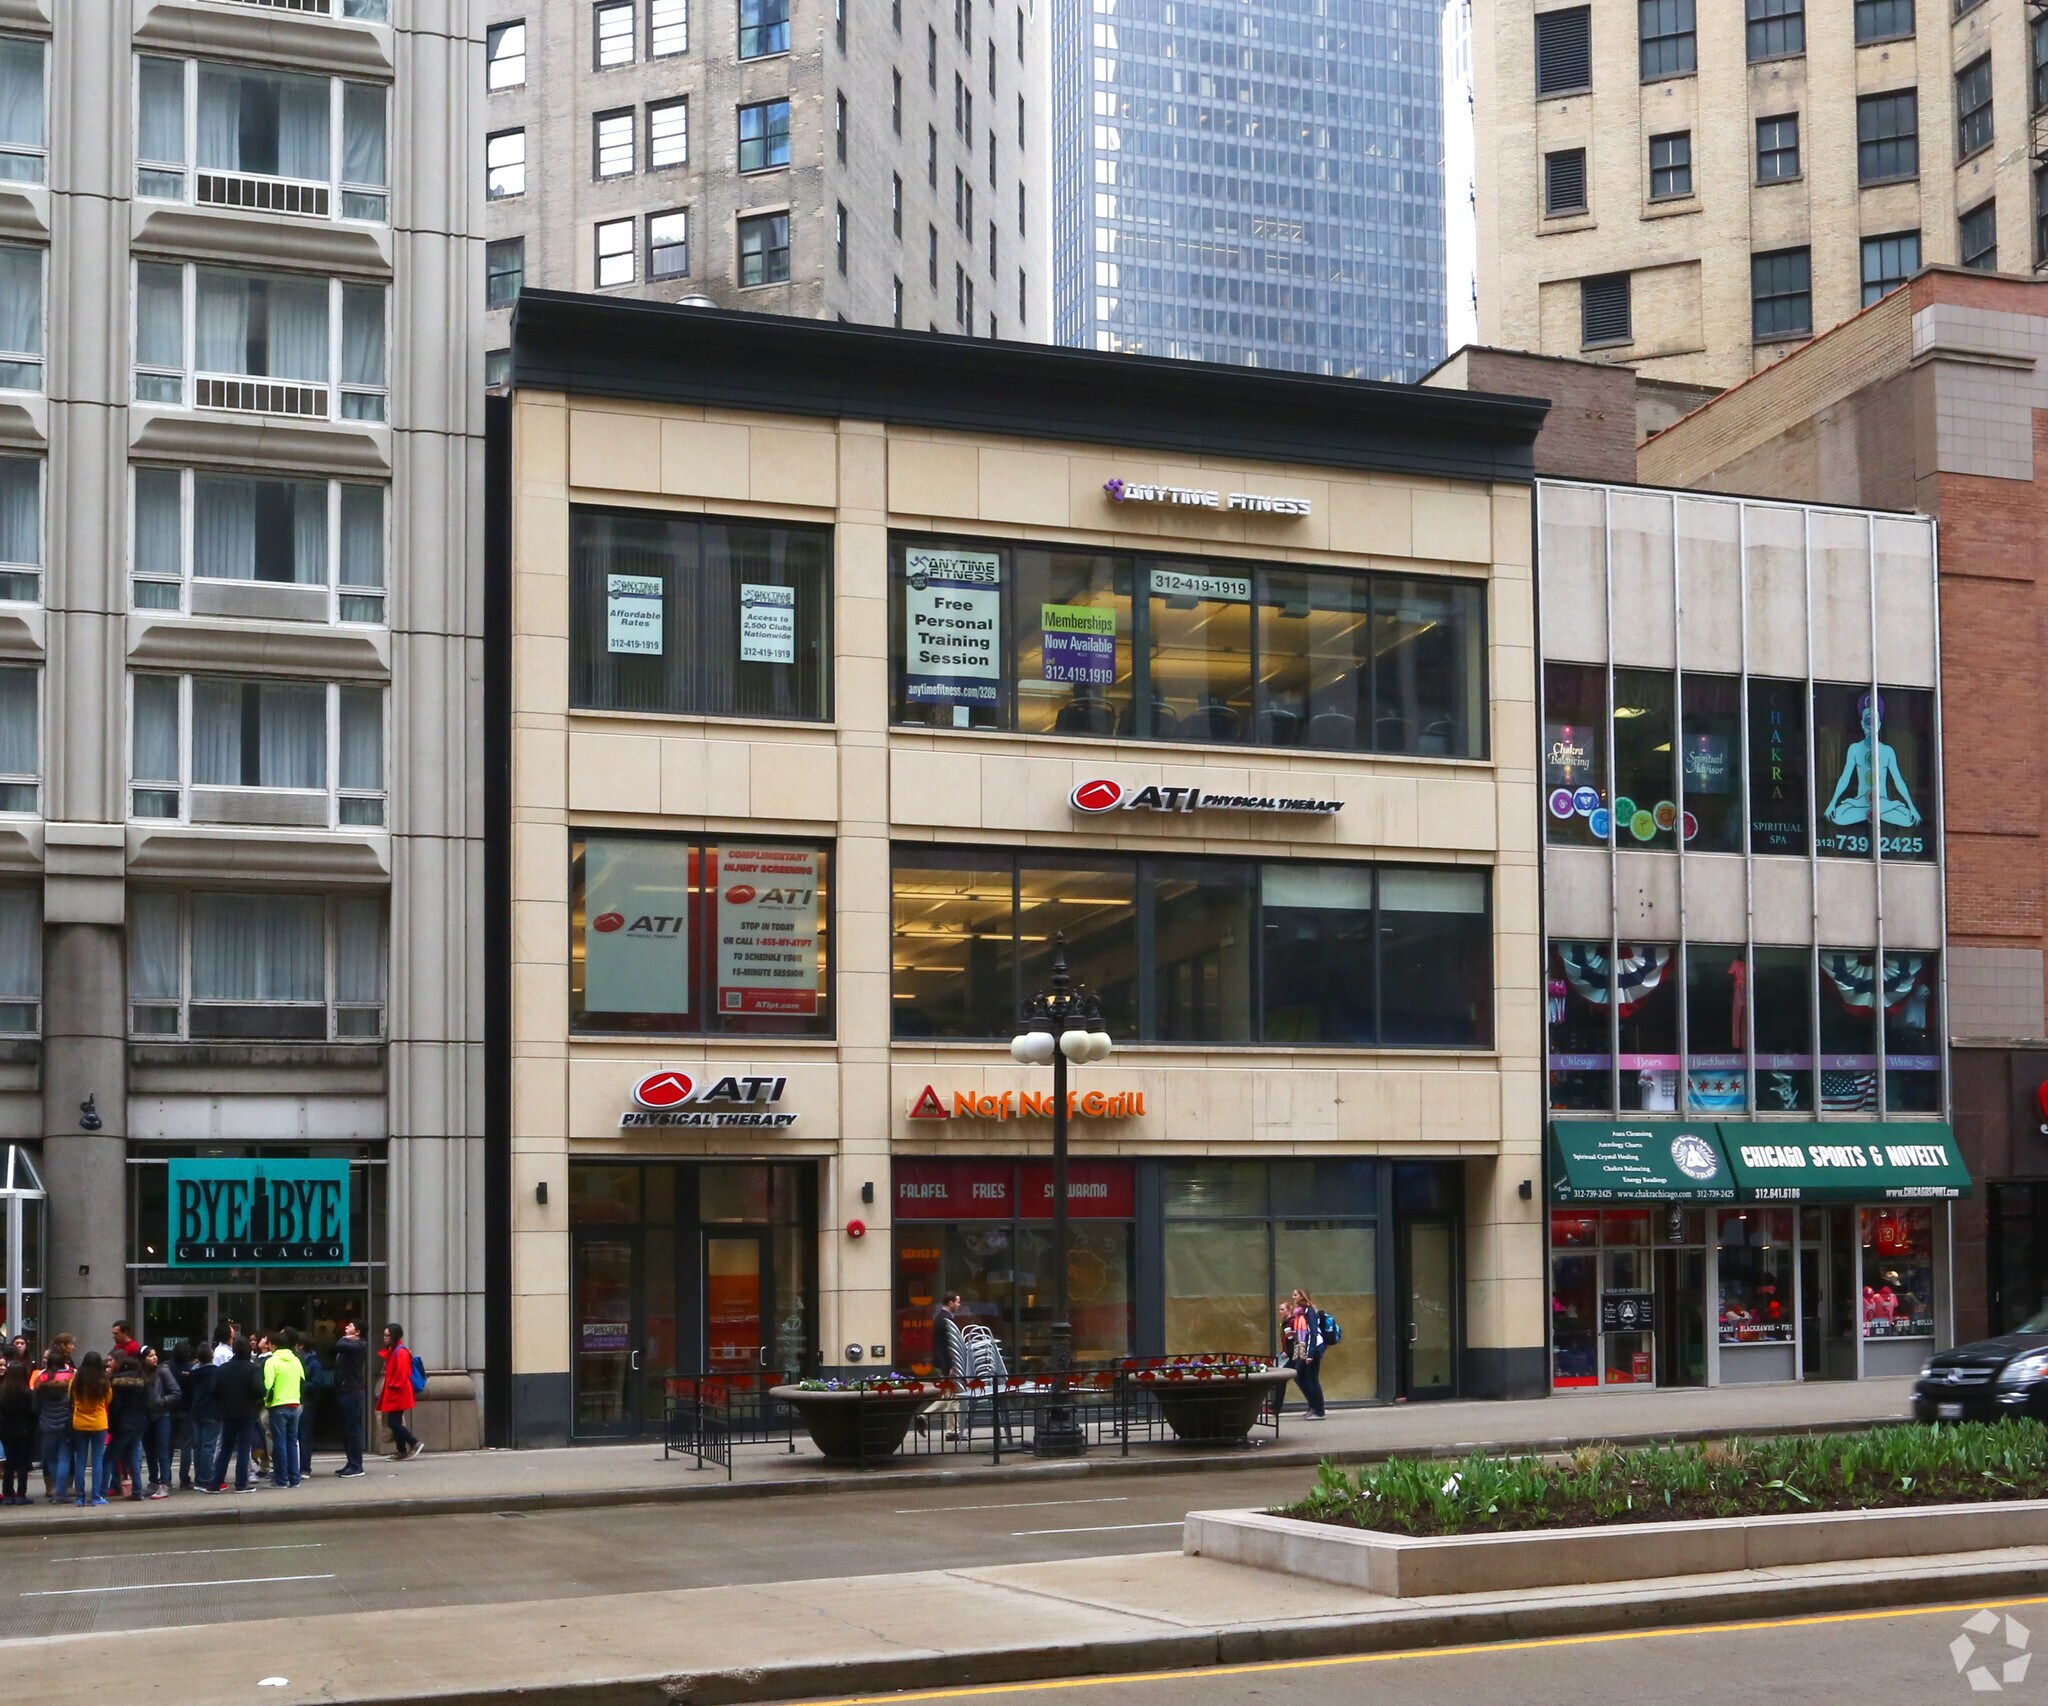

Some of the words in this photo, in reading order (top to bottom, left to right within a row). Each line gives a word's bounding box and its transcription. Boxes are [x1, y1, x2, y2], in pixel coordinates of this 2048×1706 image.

[1123, 483, 1219, 508] ANYTIME
[1228, 492, 1311, 515] FITNESS
[929, 557, 995, 572] ANYTIME
[929, 568, 995, 582] FITNESS
[621, 581, 660, 590] ANYTIME
[1155, 574, 1246, 595] 312-419-1919
[934, 597, 973, 611] Free
[610, 609, 661, 620] Affordable
[747, 613, 778, 622] Access
[621, 618, 650, 627] Rates
[743, 622, 767, 630] 2,500
[769, 623, 792, 631] Clubs
[915, 614, 993, 630] Personal
[1045, 611, 1113, 634] Memberships
[744, 630, 792, 640] Nationwide
[918, 632, 990, 650] Training
[611, 638, 659, 649] 312-419-1919
[1044, 634, 1068, 650] Now
[1070, 635, 1113, 653] Available
[744, 647, 791, 658] 312-419-1919
[919, 650, 989, 666] Session
[1045, 664, 1113, 684] 312.419.1919
[1552, 742, 1584, 755] Chakra
[1547, 752, 1590, 771] Balancing
[1686, 751, 1723, 764] Spiritual
[1128, 786, 1200, 810] ATI
[1202, 794, 1276, 809] PHYSICAL
[1278, 799, 1346, 813] THERAPY
[1753, 821, 1803, 832] SPIRITUAL
[1769, 835, 1787, 844] SPA
[1816, 838, 1835, 849] 312)
[1835, 834, 1869, 852] 739
[1880, 836, 1923, 853] 2425
[728, 850, 809, 862] COMPLIMENTARY
[723, 863, 759, 873] INJURY
[760, 864, 813, 875] SCREENING
[759, 888, 813, 905] ATI
[626, 915, 684, 933] ATI
[740, 921, 760, 930] STOP
[761, 922, 770, 931] IN
[771, 923, 795, 932] TODAY
[723, 936, 734, 945] OR
[735, 937, 753, 946] CALL
[733, 952, 743, 960] TO
[744, 952, 782, 962] SCHEDULE
[783, 954, 803, 963] YOUR
[732, 967, 772, 977] 15-MINUTE
[772, 969, 804, 978] SESSION
[1560, 1056, 1597, 1070] Chicago
[1633, 1056, 1663, 1069] Bears
[1690, 1056, 1742, 1069] Blackhawks
[701, 1076, 788, 1102] ATI
[954, 1090, 1014, 1121] Naf
[1081, 1090, 1147, 1118] Grill
[621, 1112, 712, 1126] PHYSICAL
[715, 1113, 799, 1126] THERAPY
[1740, 1145, 1807, 1168] CHICAGO
[1808, 1145, 1868, 1168] SPORTS
[1868, 1145, 1884, 1167] &
[1885, 1145, 1950, 1167] NOVELTY
[900, 1183, 948, 1199] FALAFEL
[972, 1183, 1006, 1199] FRIES
[1044, 1183, 1108, 1199] SWARMA
[1573, 1189, 1613, 1198] 312-739-2425
[1696, 1189, 1735, 1198] 312-739-2425
[176, 1179, 248, 1243] BYE
[270, 1179, 341, 1243] BYE
[179, 1246, 340, 1258] CHICAGO
[1719, 1325, 1734, 1333] EARS
